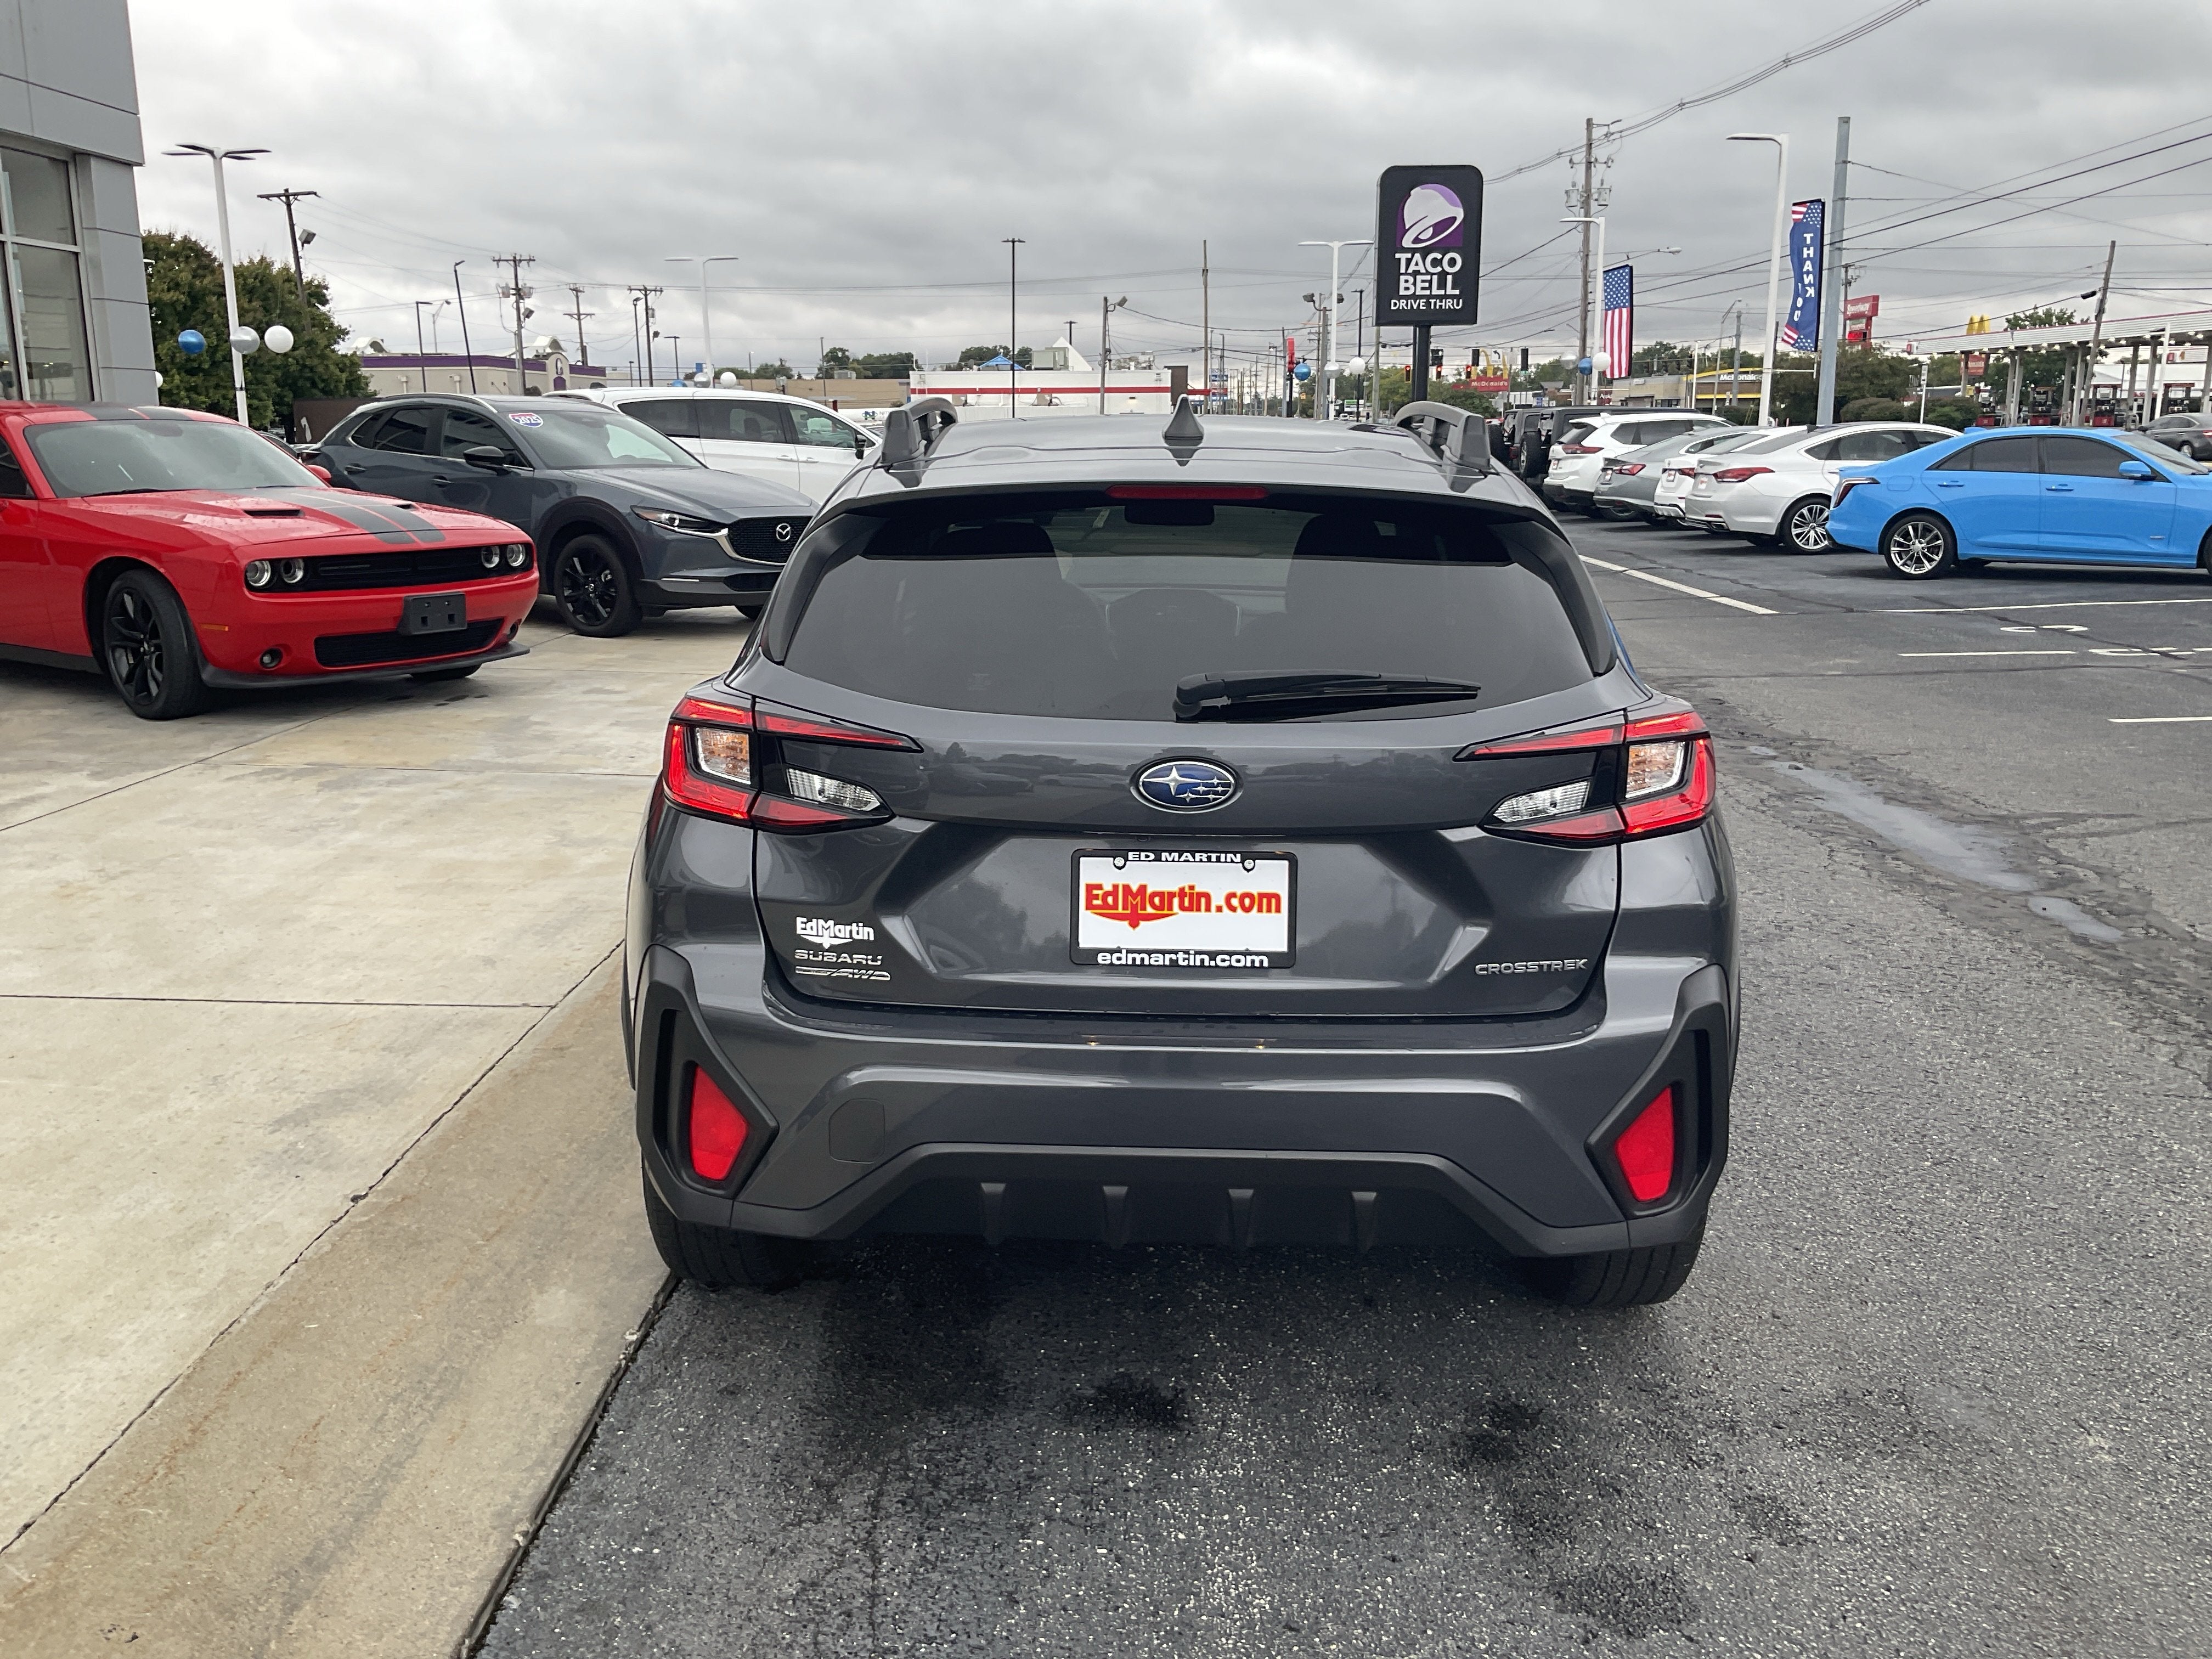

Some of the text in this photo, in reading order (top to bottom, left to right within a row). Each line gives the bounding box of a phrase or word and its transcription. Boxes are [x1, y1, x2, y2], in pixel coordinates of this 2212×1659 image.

[1395, 252, 1462, 273] TACO
[1399, 274, 1460, 295] BELL
[1391, 298, 1463, 310] DRIVE THRU
[514, 416, 541, 424] 2025
[1127, 851, 1242, 862] ED MARTIN
[1085, 882, 1282, 914] EdMartin.com
[796, 916, 874, 941] EdMartin
[794, 949, 883, 966] SUBARU
[1097, 949, 1269, 968] edmartin.com
[827, 968, 891, 981] AWD
[1475, 958, 1588, 975] CROSSTREK
